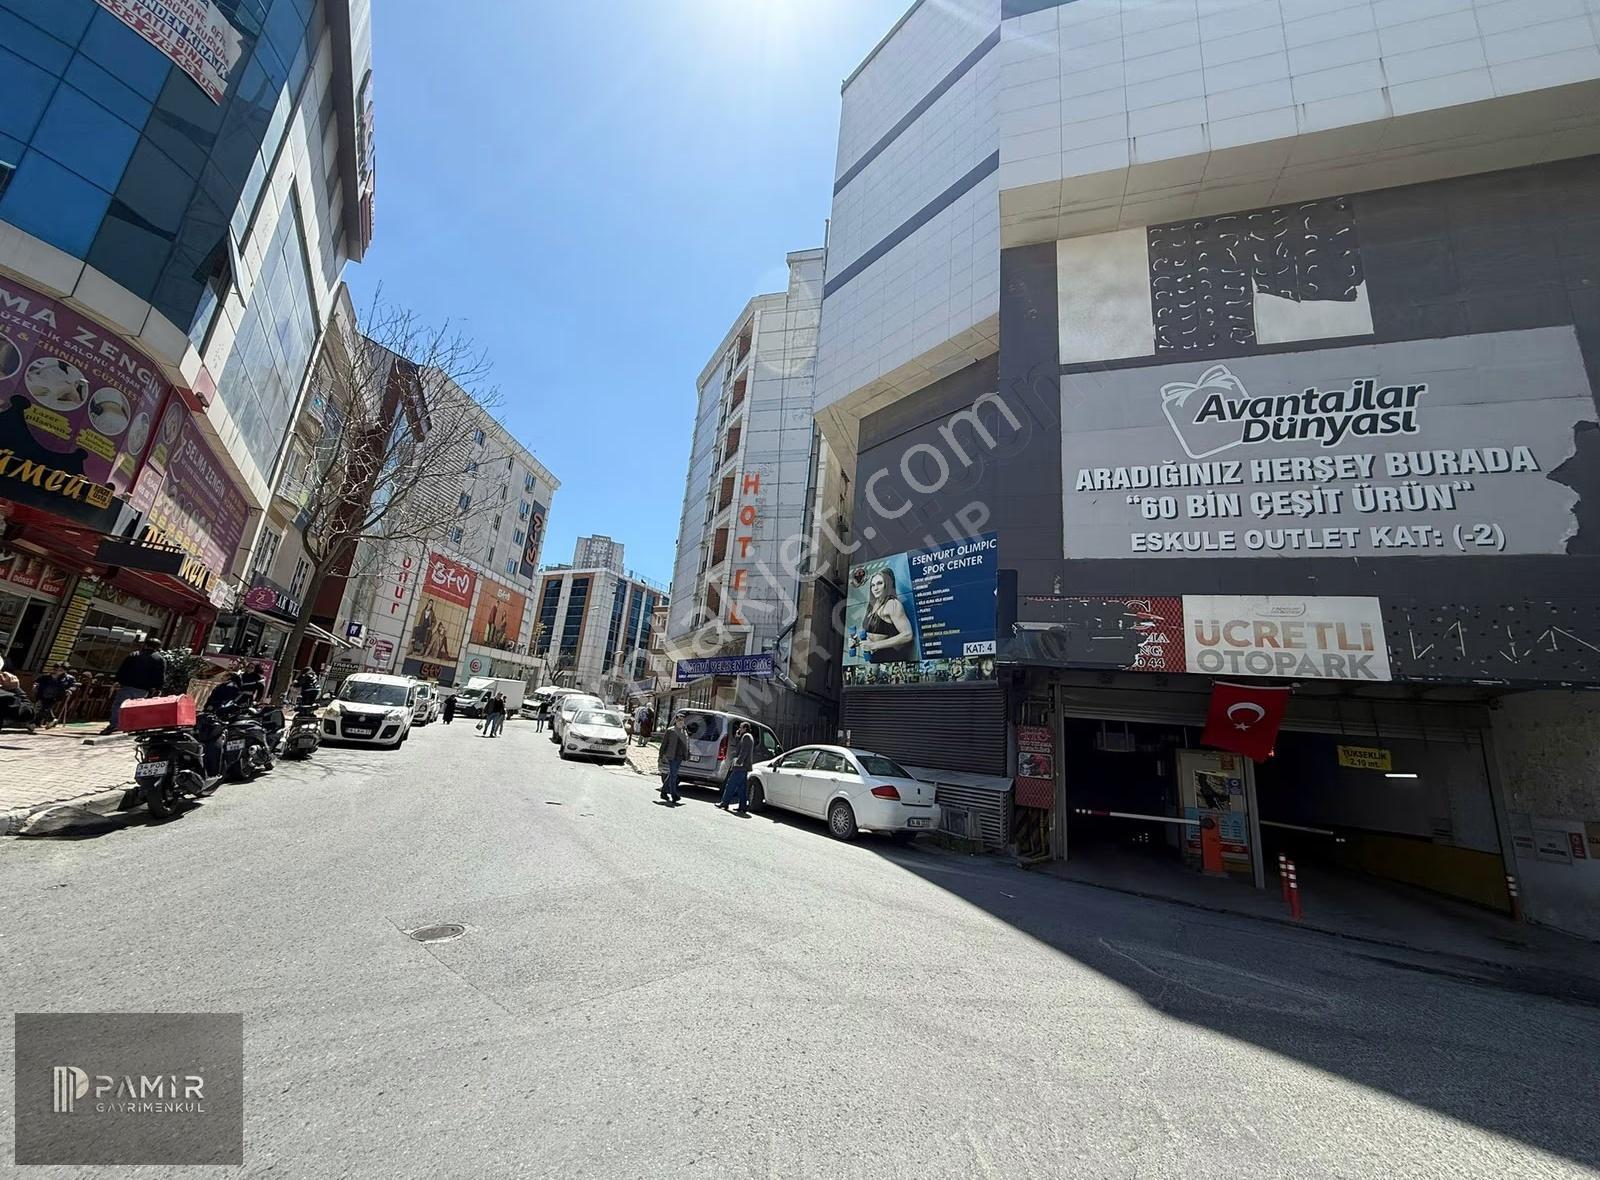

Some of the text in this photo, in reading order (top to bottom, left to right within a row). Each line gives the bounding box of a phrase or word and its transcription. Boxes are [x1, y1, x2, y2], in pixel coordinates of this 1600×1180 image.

[175, 36, 205, 70] BİNA
[63, 340, 109, 367] SALONU
[73, 325, 161, 399] ZENGİN
[1194, 378, 1427, 423] Avantajlar
[1241, 407, 1420, 447] Dünyası
[1075, 445, 1541, 491] ARADIĞINIZ HERŞEY BURADA
[1187, 488, 1242, 519] BİN
[1250, 484, 1343, 520] ÇEŞİT
[730, 472, 760, 626] HOTEL
[1131, 522, 1506, 553] ESKULE OUTLET KAT: (-2)
[912, 547, 954, 566] ESENYURT
[922, 555, 984, 576] SPOR CENTER
[965, 642, 993, 654] KAT: 4
[1194, 619, 1375, 652] ÜCRETLİ
[744, 658, 772, 671] HOME
[1196, 648, 1379, 680] OTOPARK
